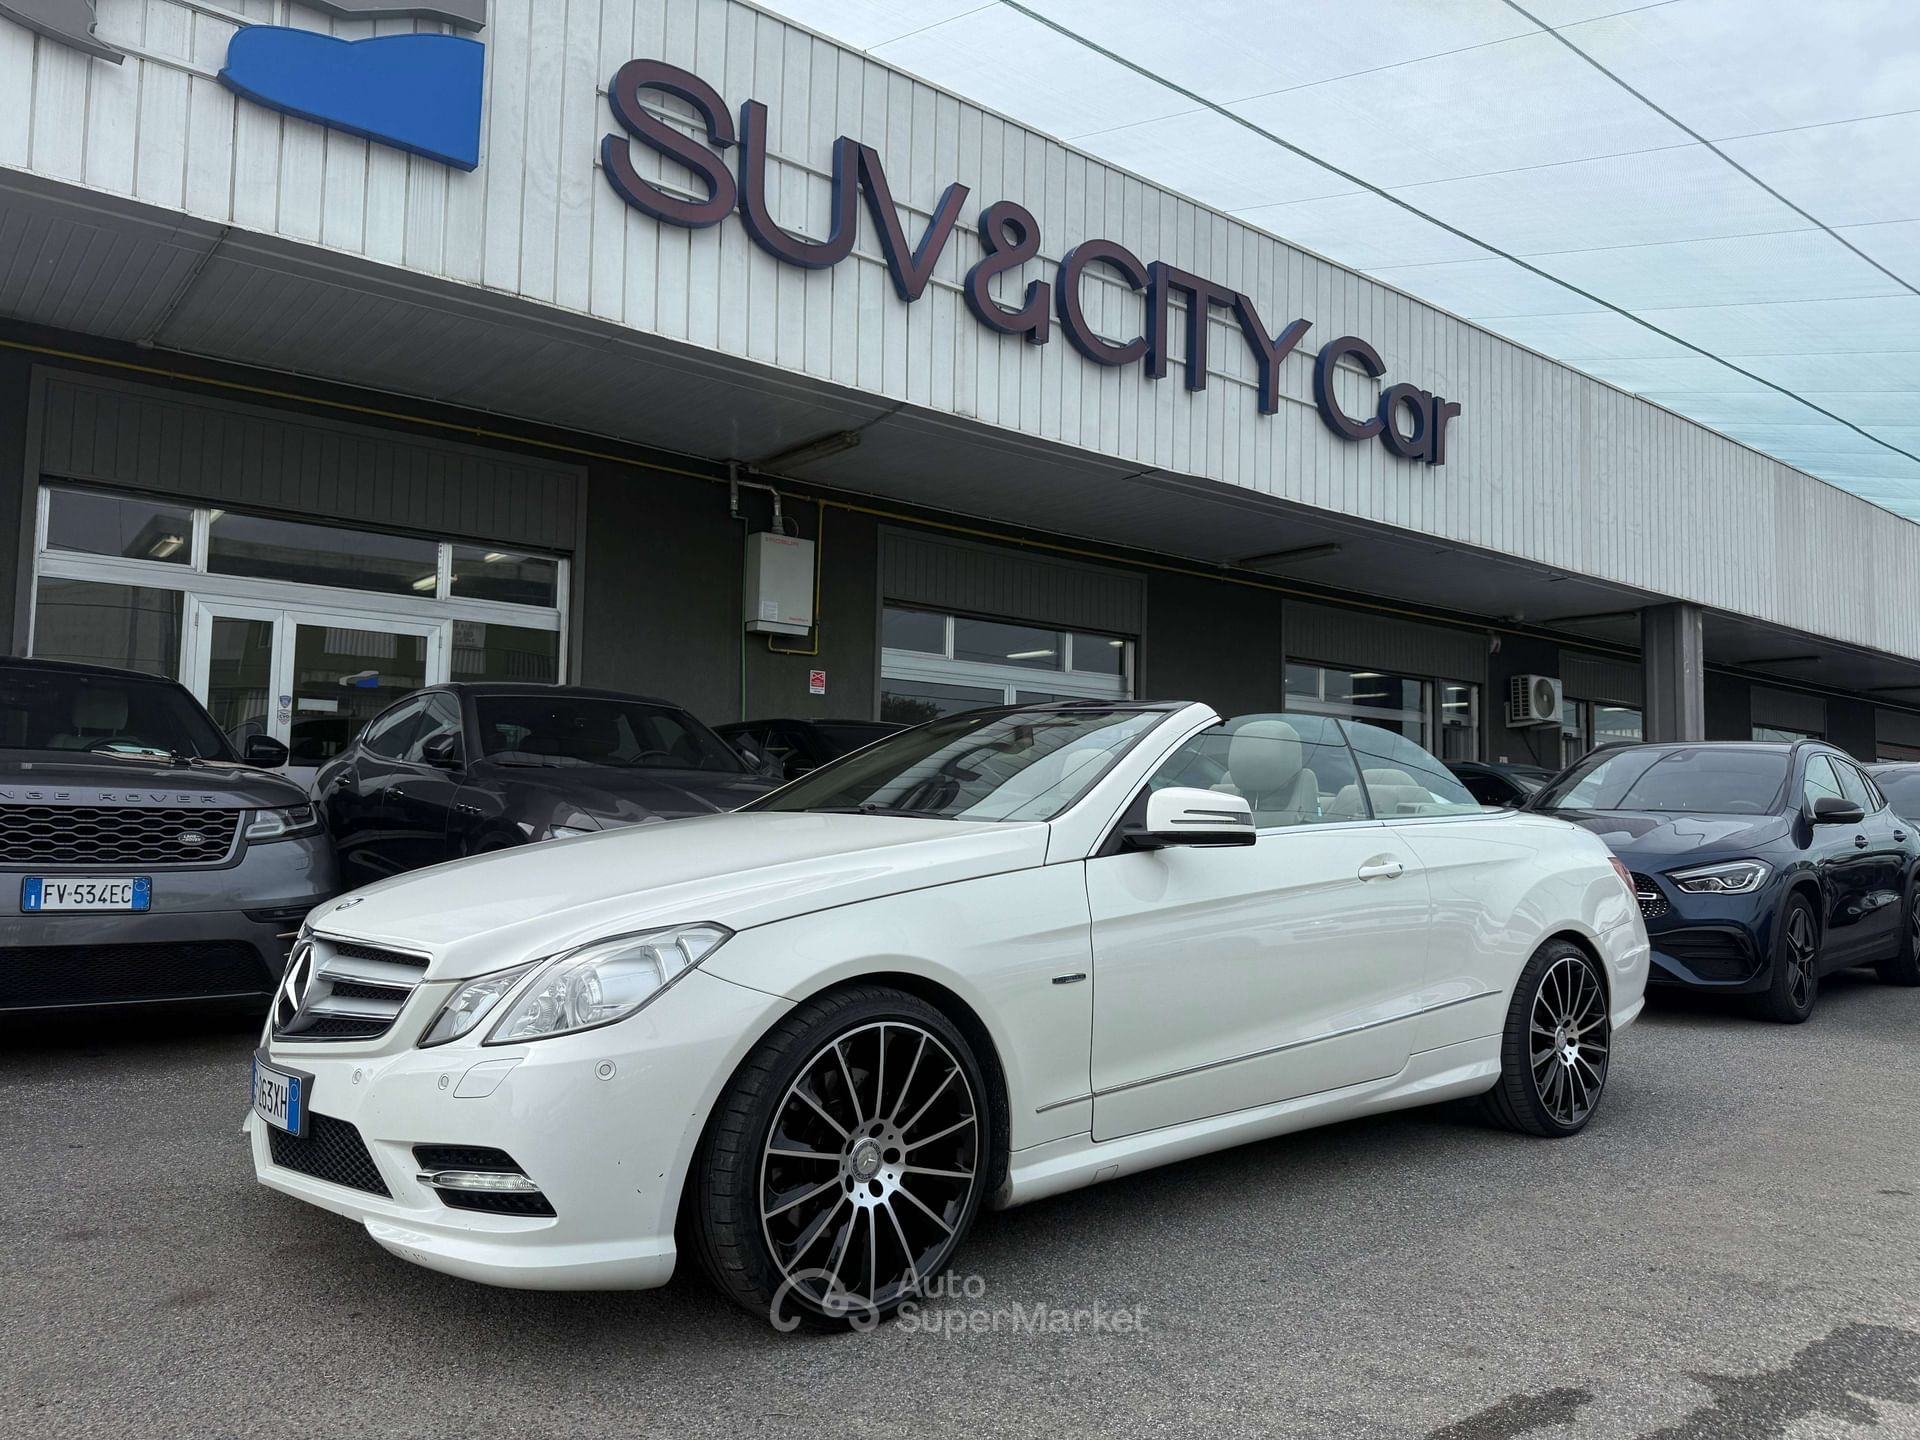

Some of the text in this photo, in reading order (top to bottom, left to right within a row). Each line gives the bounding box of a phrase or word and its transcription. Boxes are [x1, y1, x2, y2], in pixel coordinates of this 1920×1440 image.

[1314, 335, 1461, 466] Car
[98, 793, 217, 804] ROVER
[255, 1068, 288, 1121] 263XH
